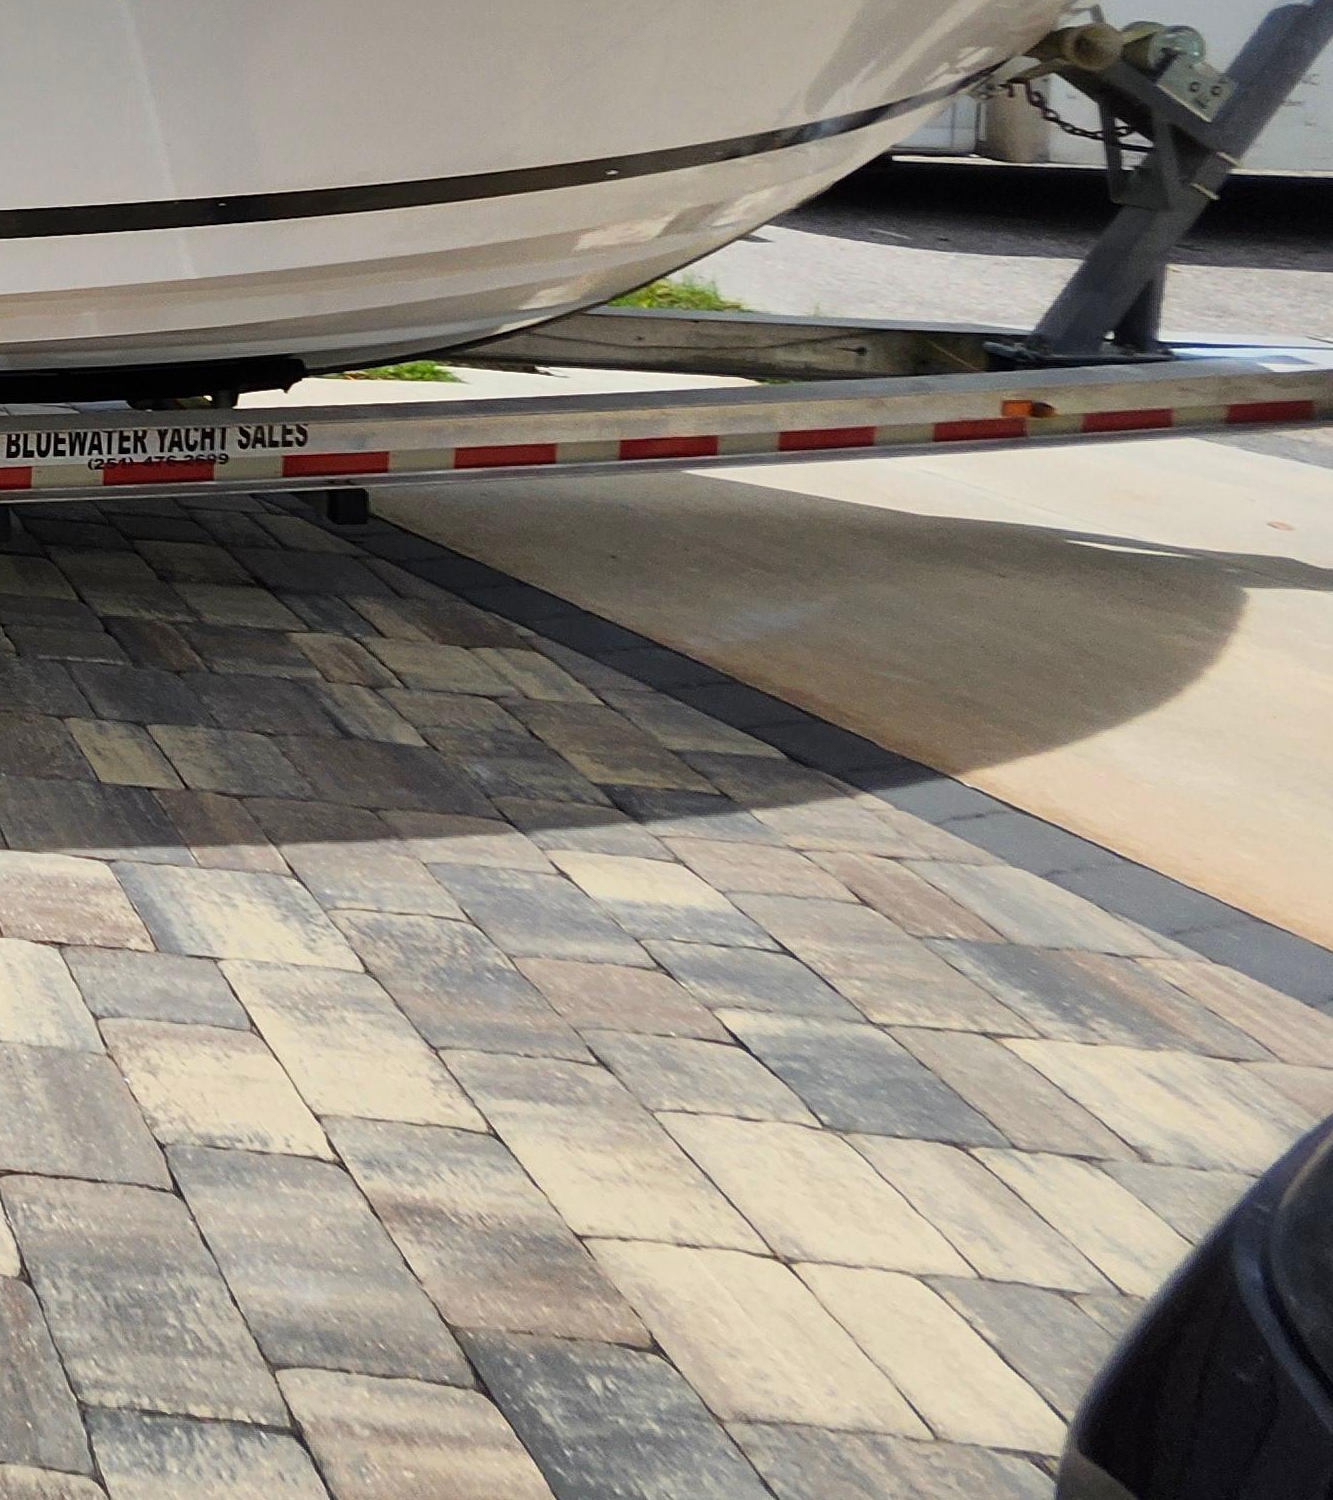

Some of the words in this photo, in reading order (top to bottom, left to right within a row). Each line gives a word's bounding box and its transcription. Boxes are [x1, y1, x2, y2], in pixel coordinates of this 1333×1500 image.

[6, 429, 147, 458] BLUEWATER
[157, 427, 227, 452] YACHT
[237, 423, 309, 450] SALES
